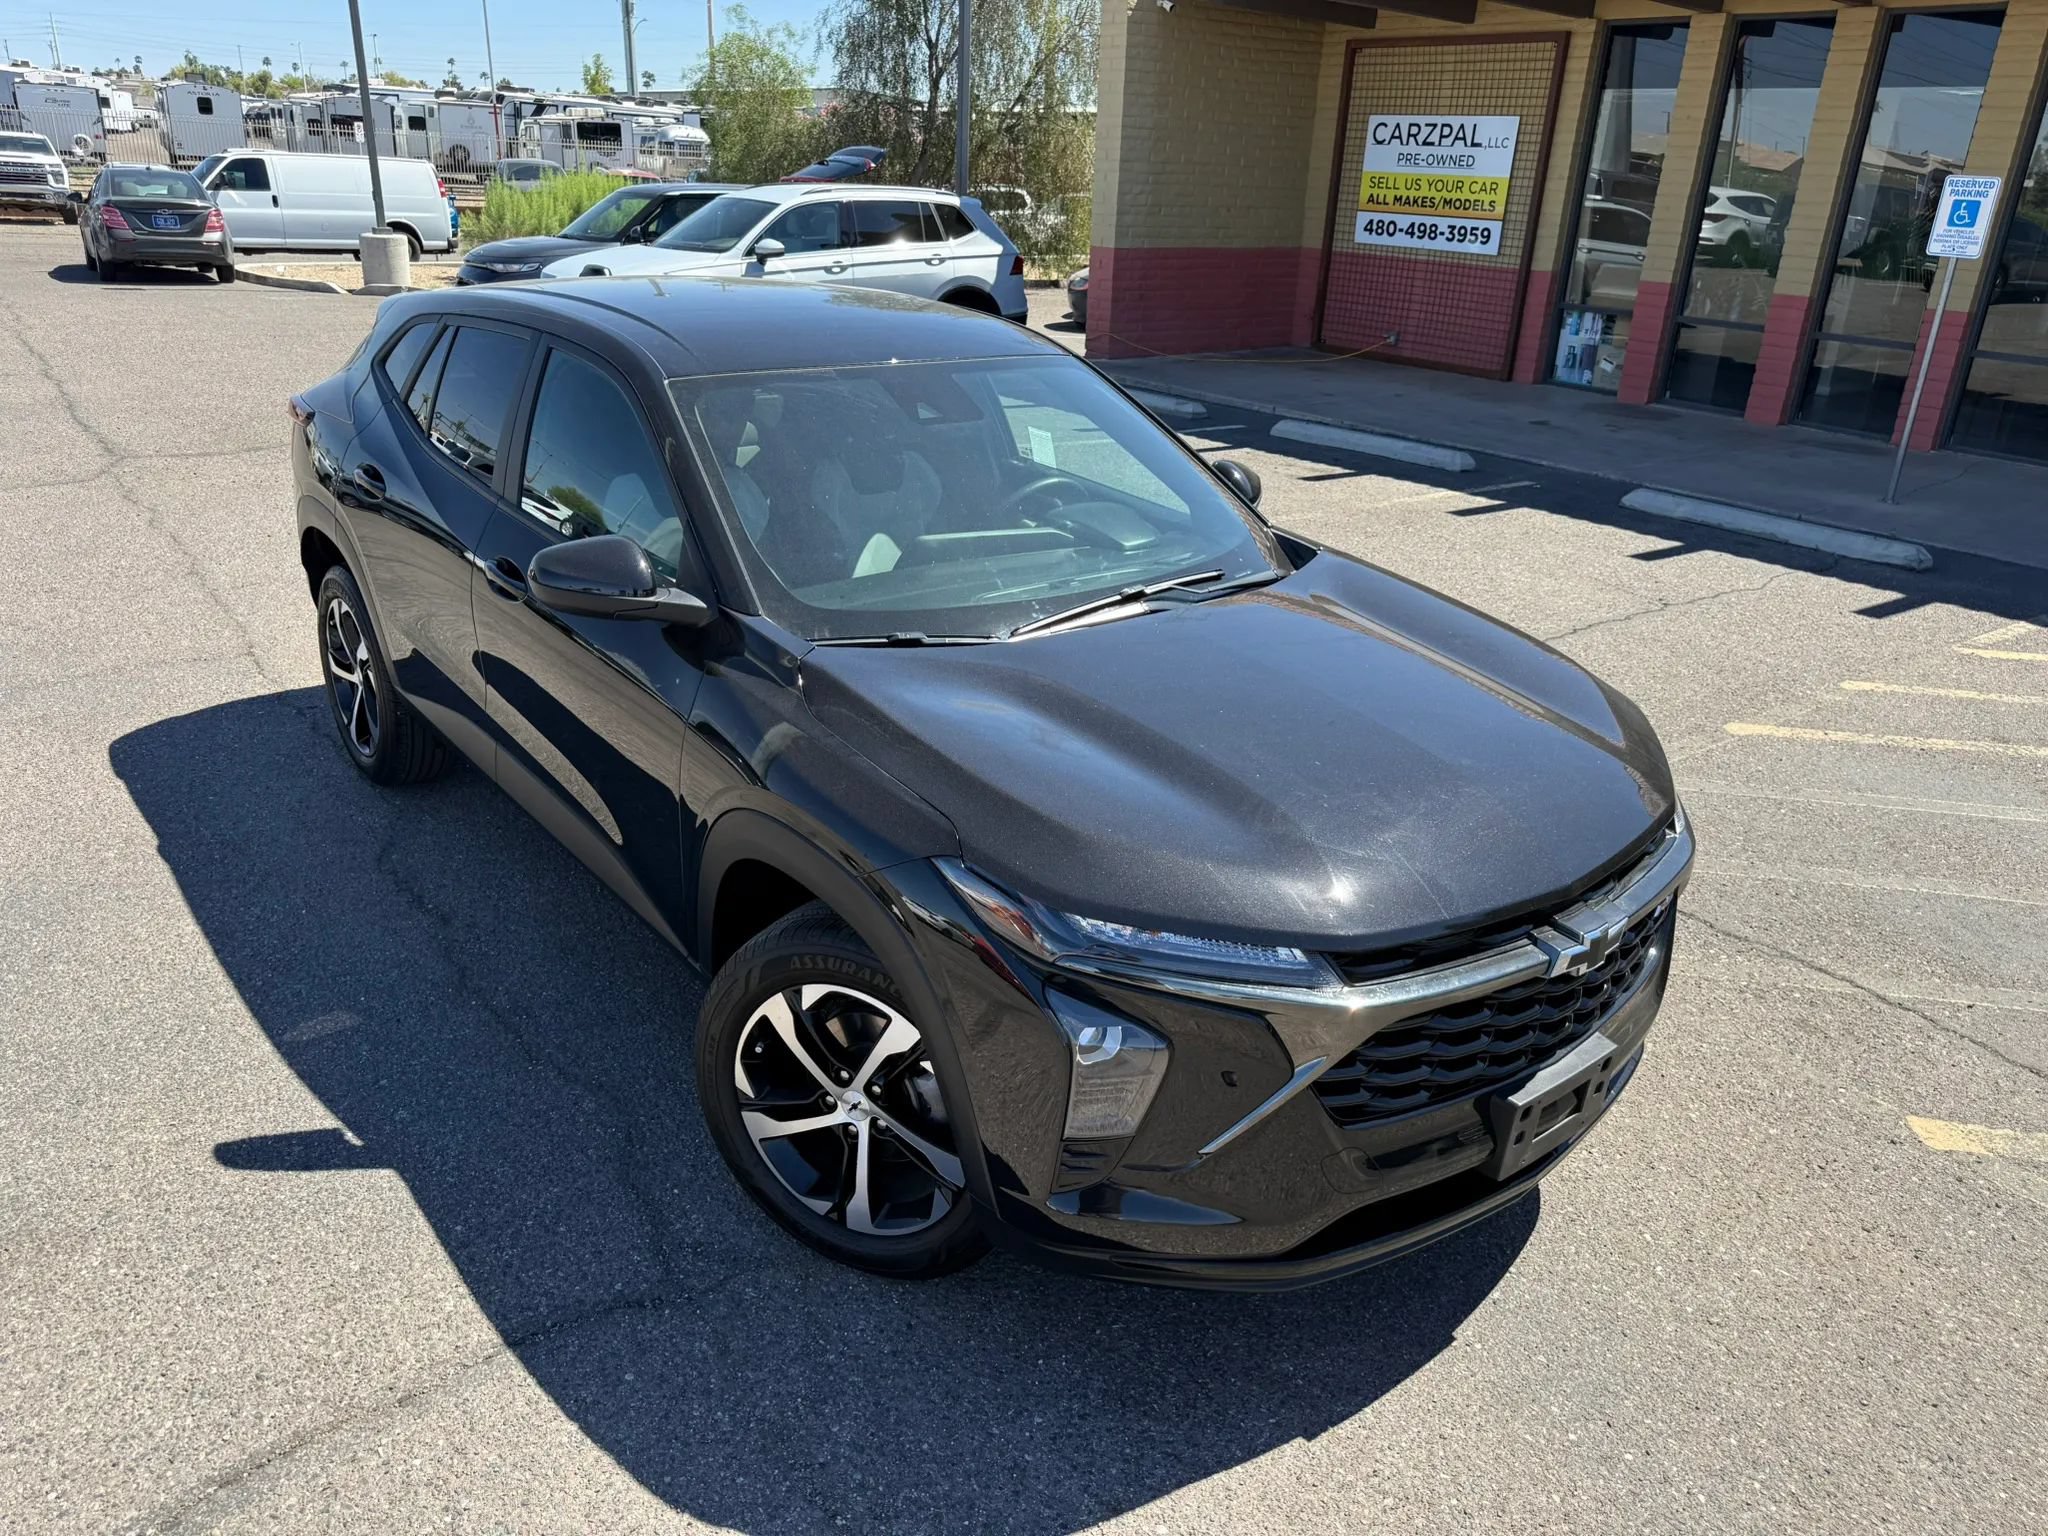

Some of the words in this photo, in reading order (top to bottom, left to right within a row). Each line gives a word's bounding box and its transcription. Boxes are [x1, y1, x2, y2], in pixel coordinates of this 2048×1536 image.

[1396, 152, 1476, 168] PRE-OWNED
[1369, 175, 1400, 190] SELL
[1404, 177, 1422, 191] US
[1427, 178, 1465, 194] YOUR
[1468, 180, 1499, 196] CAR
[1948, 179, 1996, 189] RESERVED
[1949, 189, 1989, 198] PARKING
[1366, 193, 1390, 206] ALL
[1392, 194, 1497, 213] MAKES/MODELS
[1363, 218, 1492, 245] 480-498-3959
